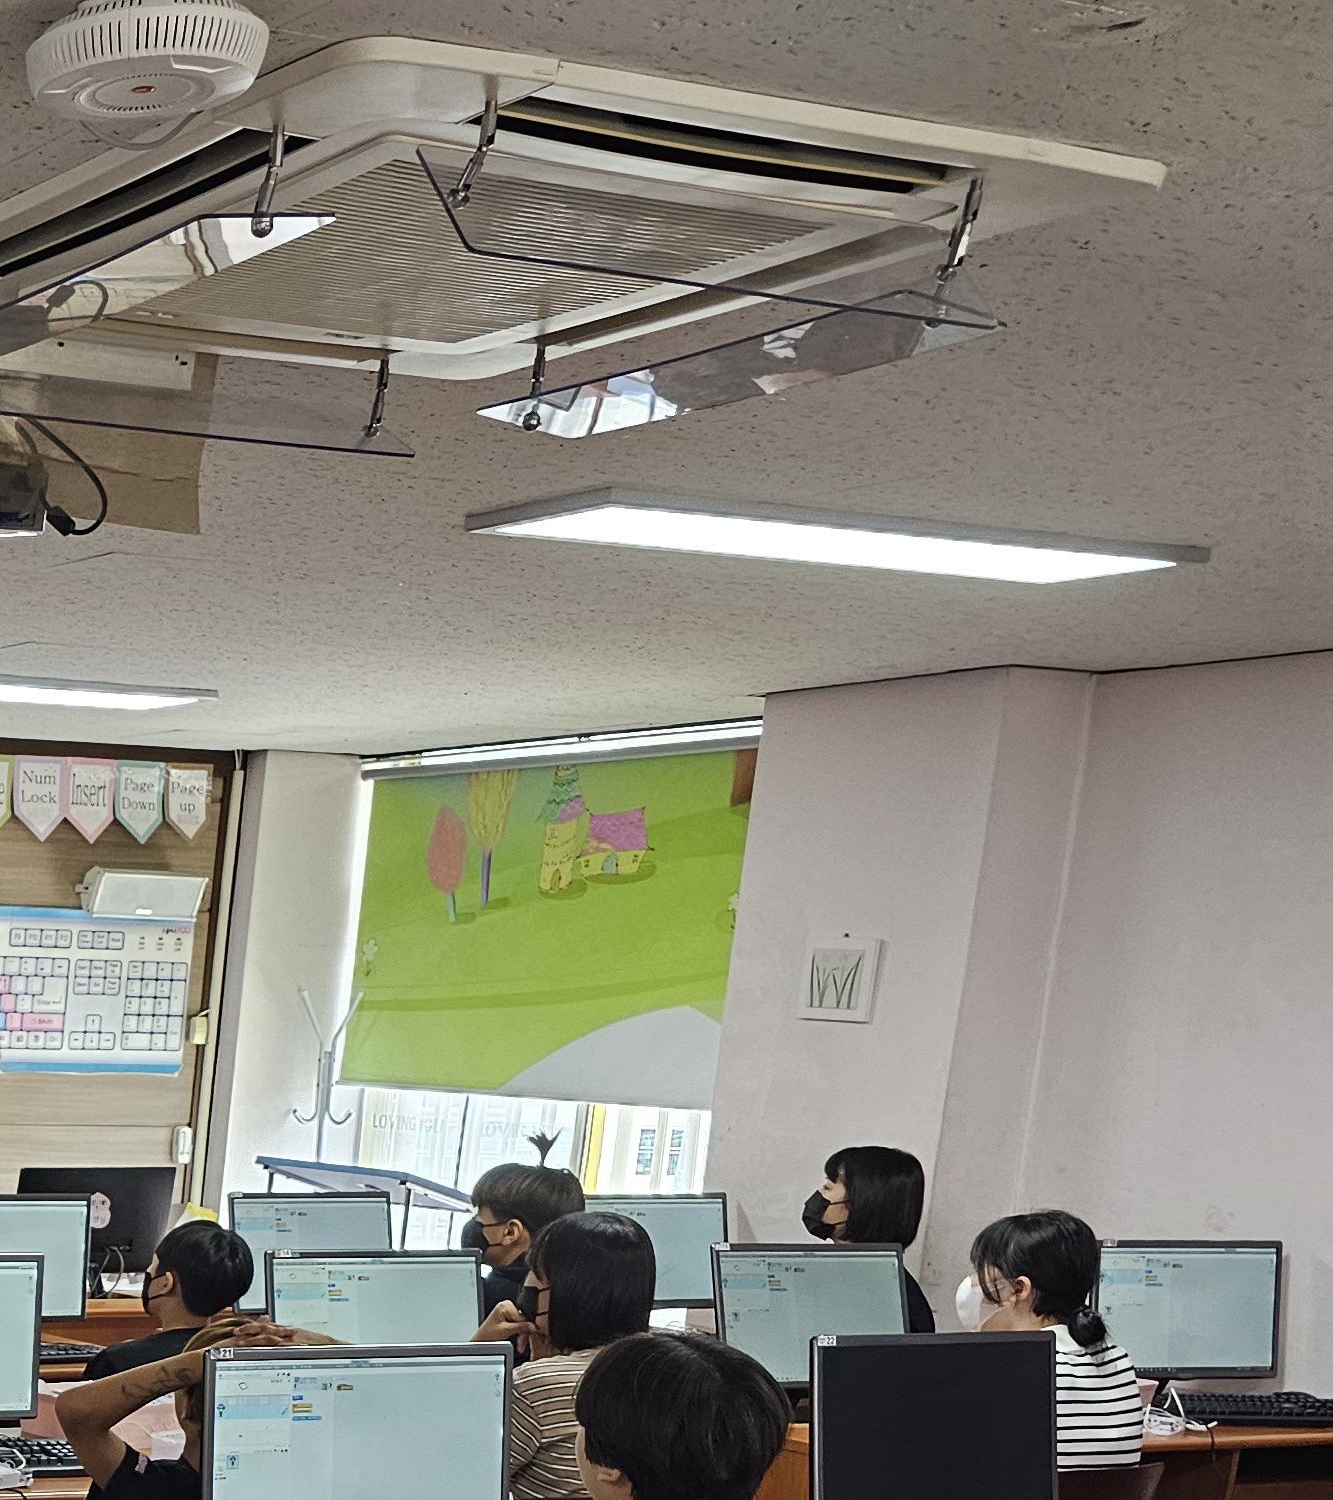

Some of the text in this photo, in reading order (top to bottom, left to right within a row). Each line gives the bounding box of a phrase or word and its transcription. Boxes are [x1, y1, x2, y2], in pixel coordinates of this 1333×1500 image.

[23, 771, 57, 785] Num
[123, 777, 155, 794] Page
[71, 773, 107, 808] Insert
[171, 782, 204, 797] Page
[20, 790, 57, 805] Lock
[121, 797, 155, 812] Down
[180, 803, 196, 815] up
[373, 1113, 416, 1129] LOVING
[223, 1349, 232, 1357] 21
